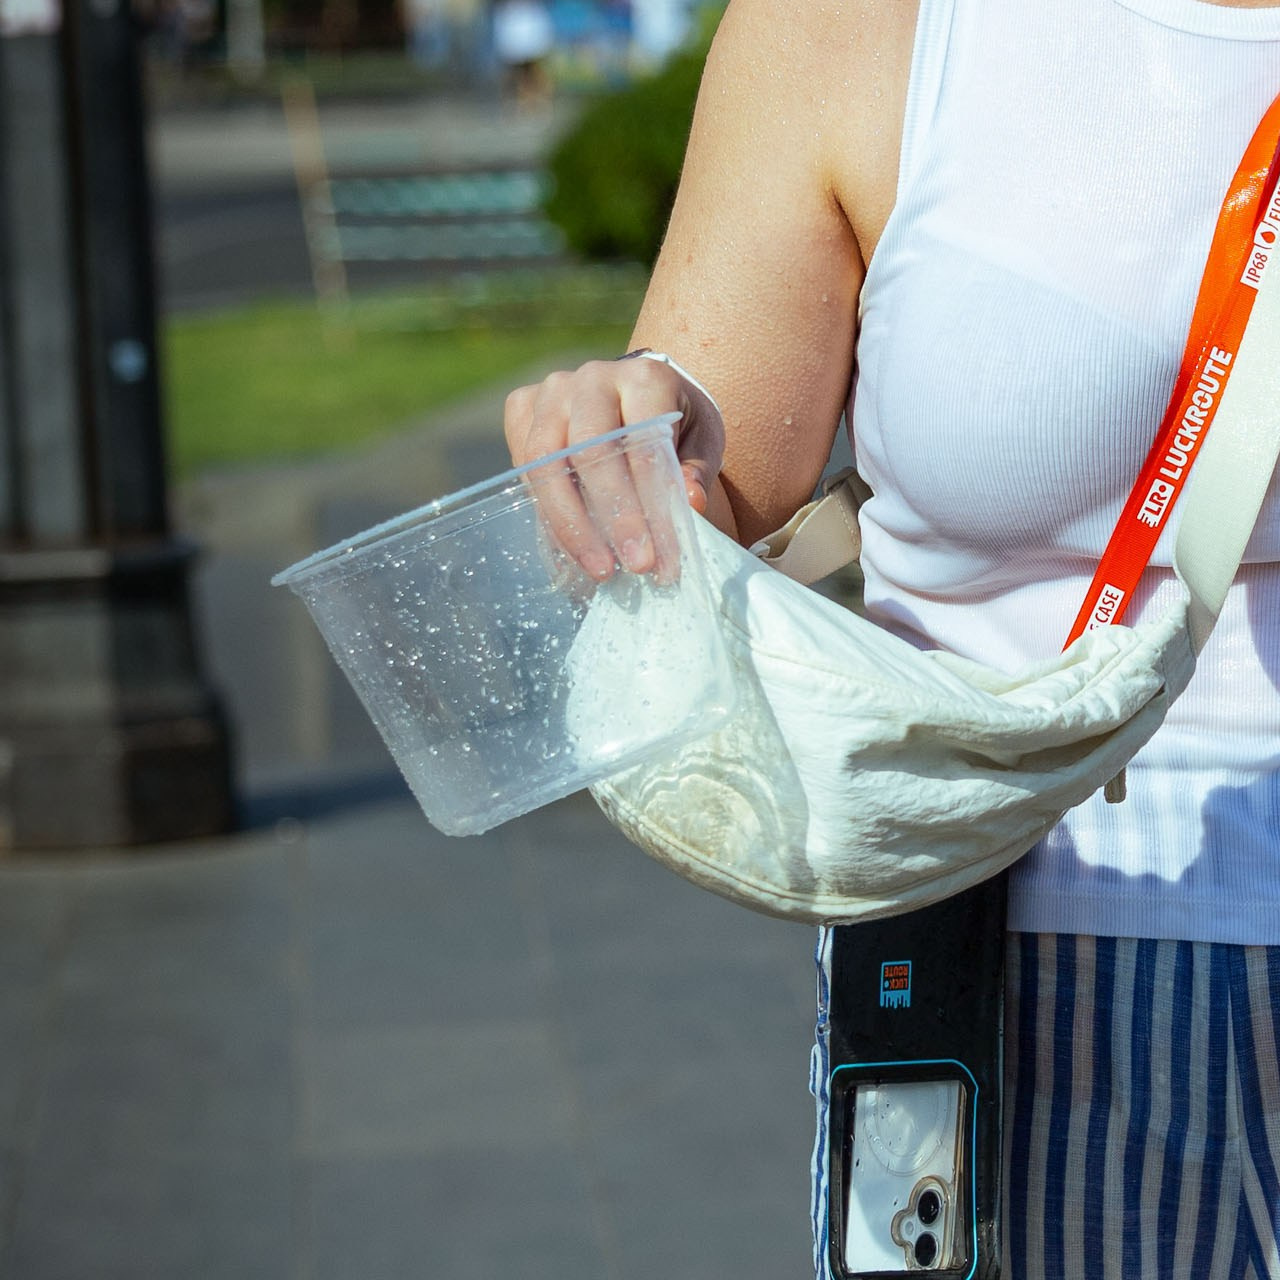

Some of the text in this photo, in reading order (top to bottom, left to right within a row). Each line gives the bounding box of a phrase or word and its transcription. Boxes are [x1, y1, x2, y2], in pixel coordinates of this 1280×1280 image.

[1245, 252, 1268, 283] IP68
[1159, 346, 1232, 480] LUCKROUTE
[1095, 590, 1119, 623] CASE
[885, 966, 908, 977] ROUTE
[890, 978, 908, 989] LUCK
